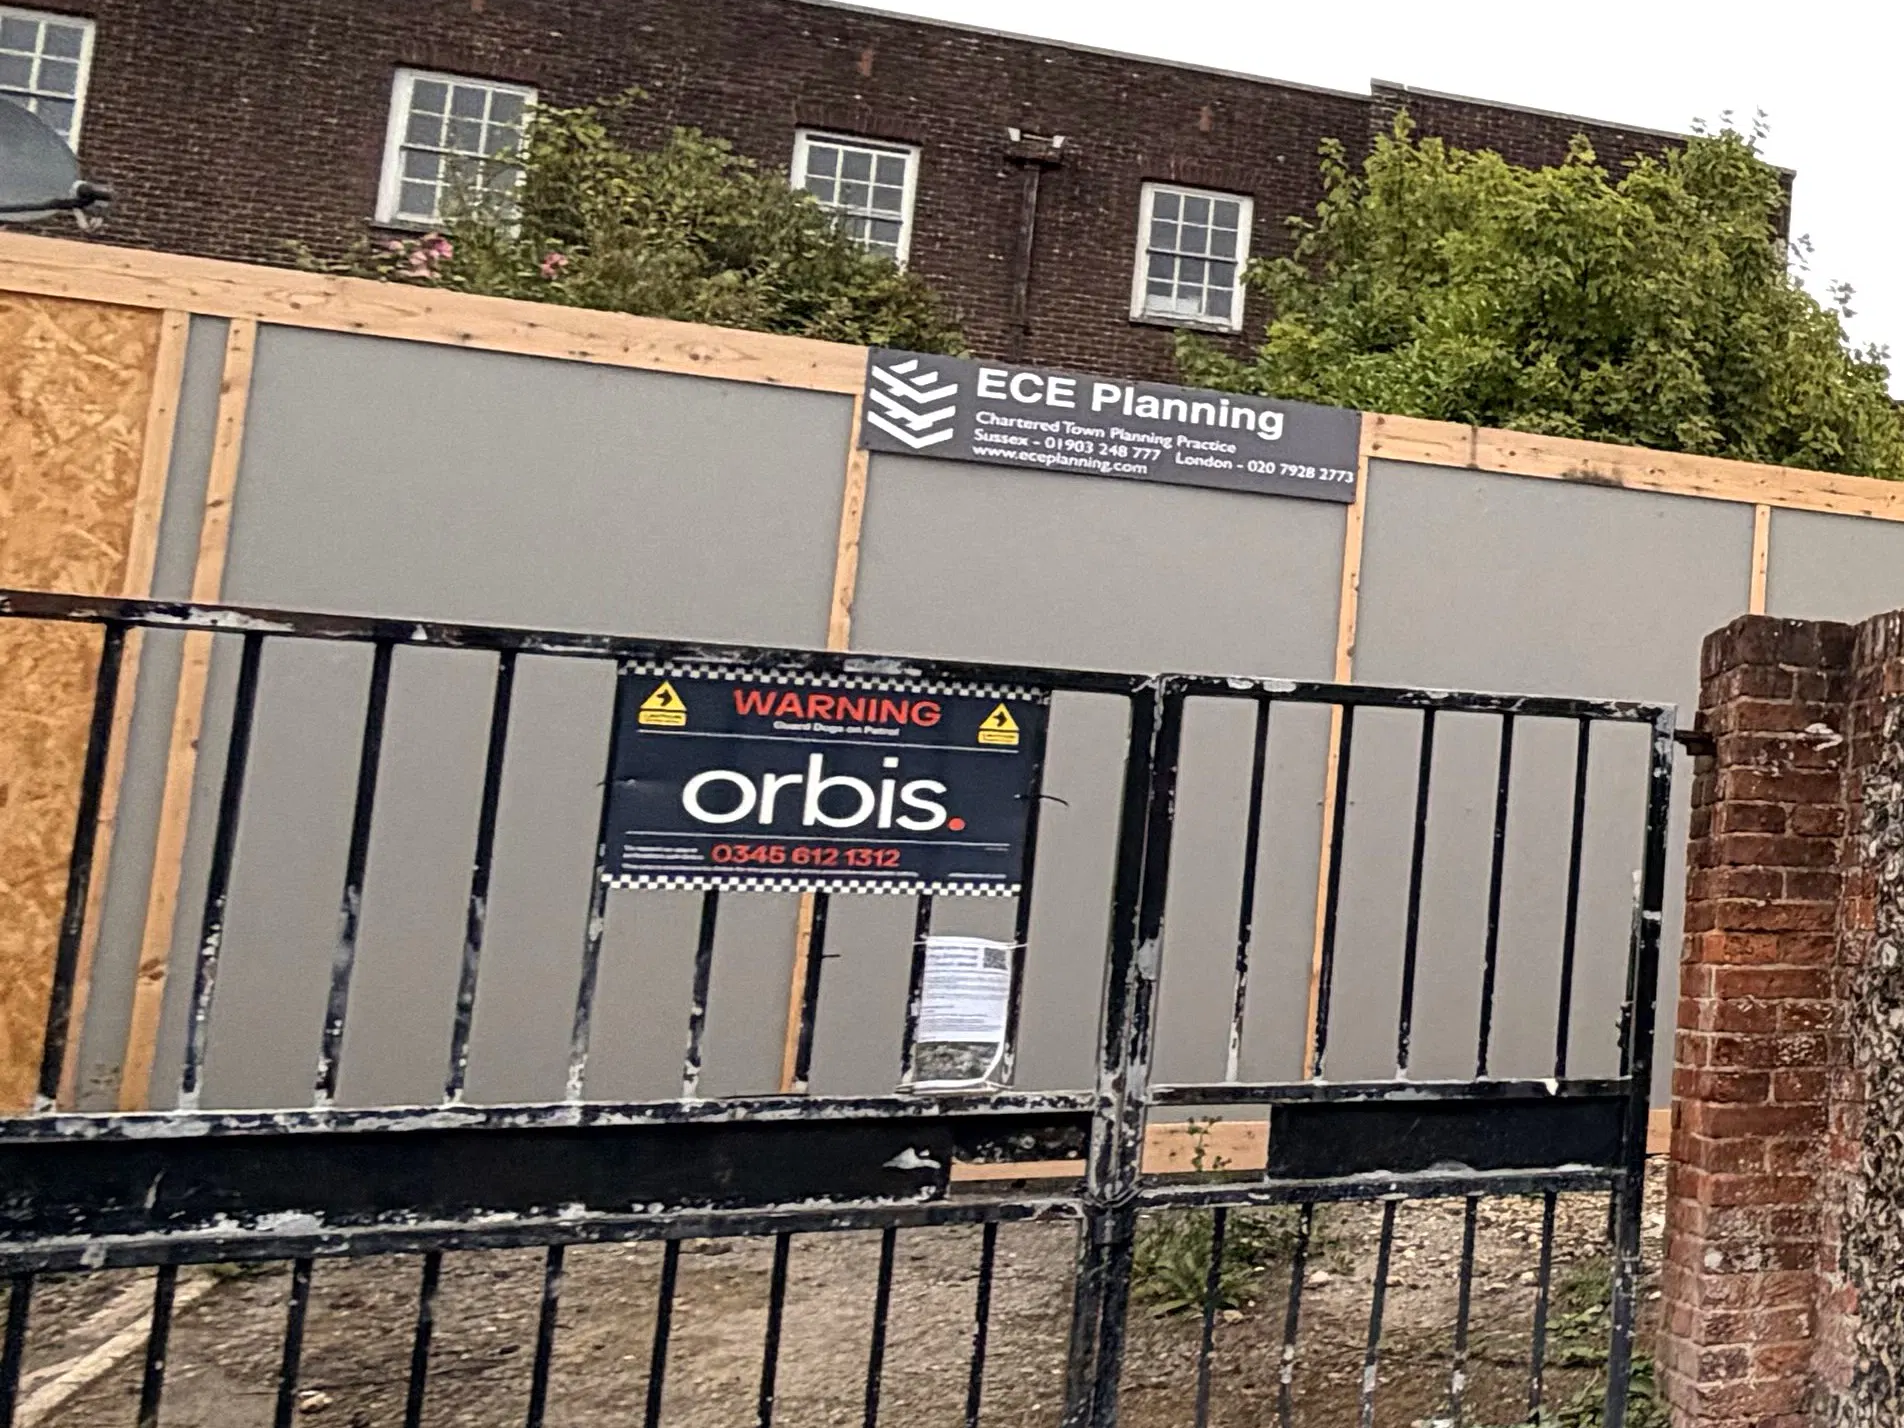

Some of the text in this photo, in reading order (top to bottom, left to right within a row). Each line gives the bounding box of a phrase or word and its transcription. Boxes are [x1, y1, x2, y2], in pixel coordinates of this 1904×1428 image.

[977, 367, 1284, 440] ECE Planning
[975, 410, 1237, 454] Chartered Town Planning Practice
[972, 445, 1148, 474] www.eceplanning.com
[974, 428, 1028, 446] Sussex
[1044, 436, 1094, 454] 01903
[1098, 442, 1128, 458] 248
[1132, 446, 1161, 461] 777
[1175, 451, 1233, 470] London
[1247, 459, 1276, 475] 020
[1280, 463, 1315, 479] 7928
[1319, 467, 1354, 483] 2773
[733, 688, 942, 728] WARNING
[711, 843, 786, 864] 0345
[791, 845, 840, 866] 612
[845, 847, 900, 868] 1312
